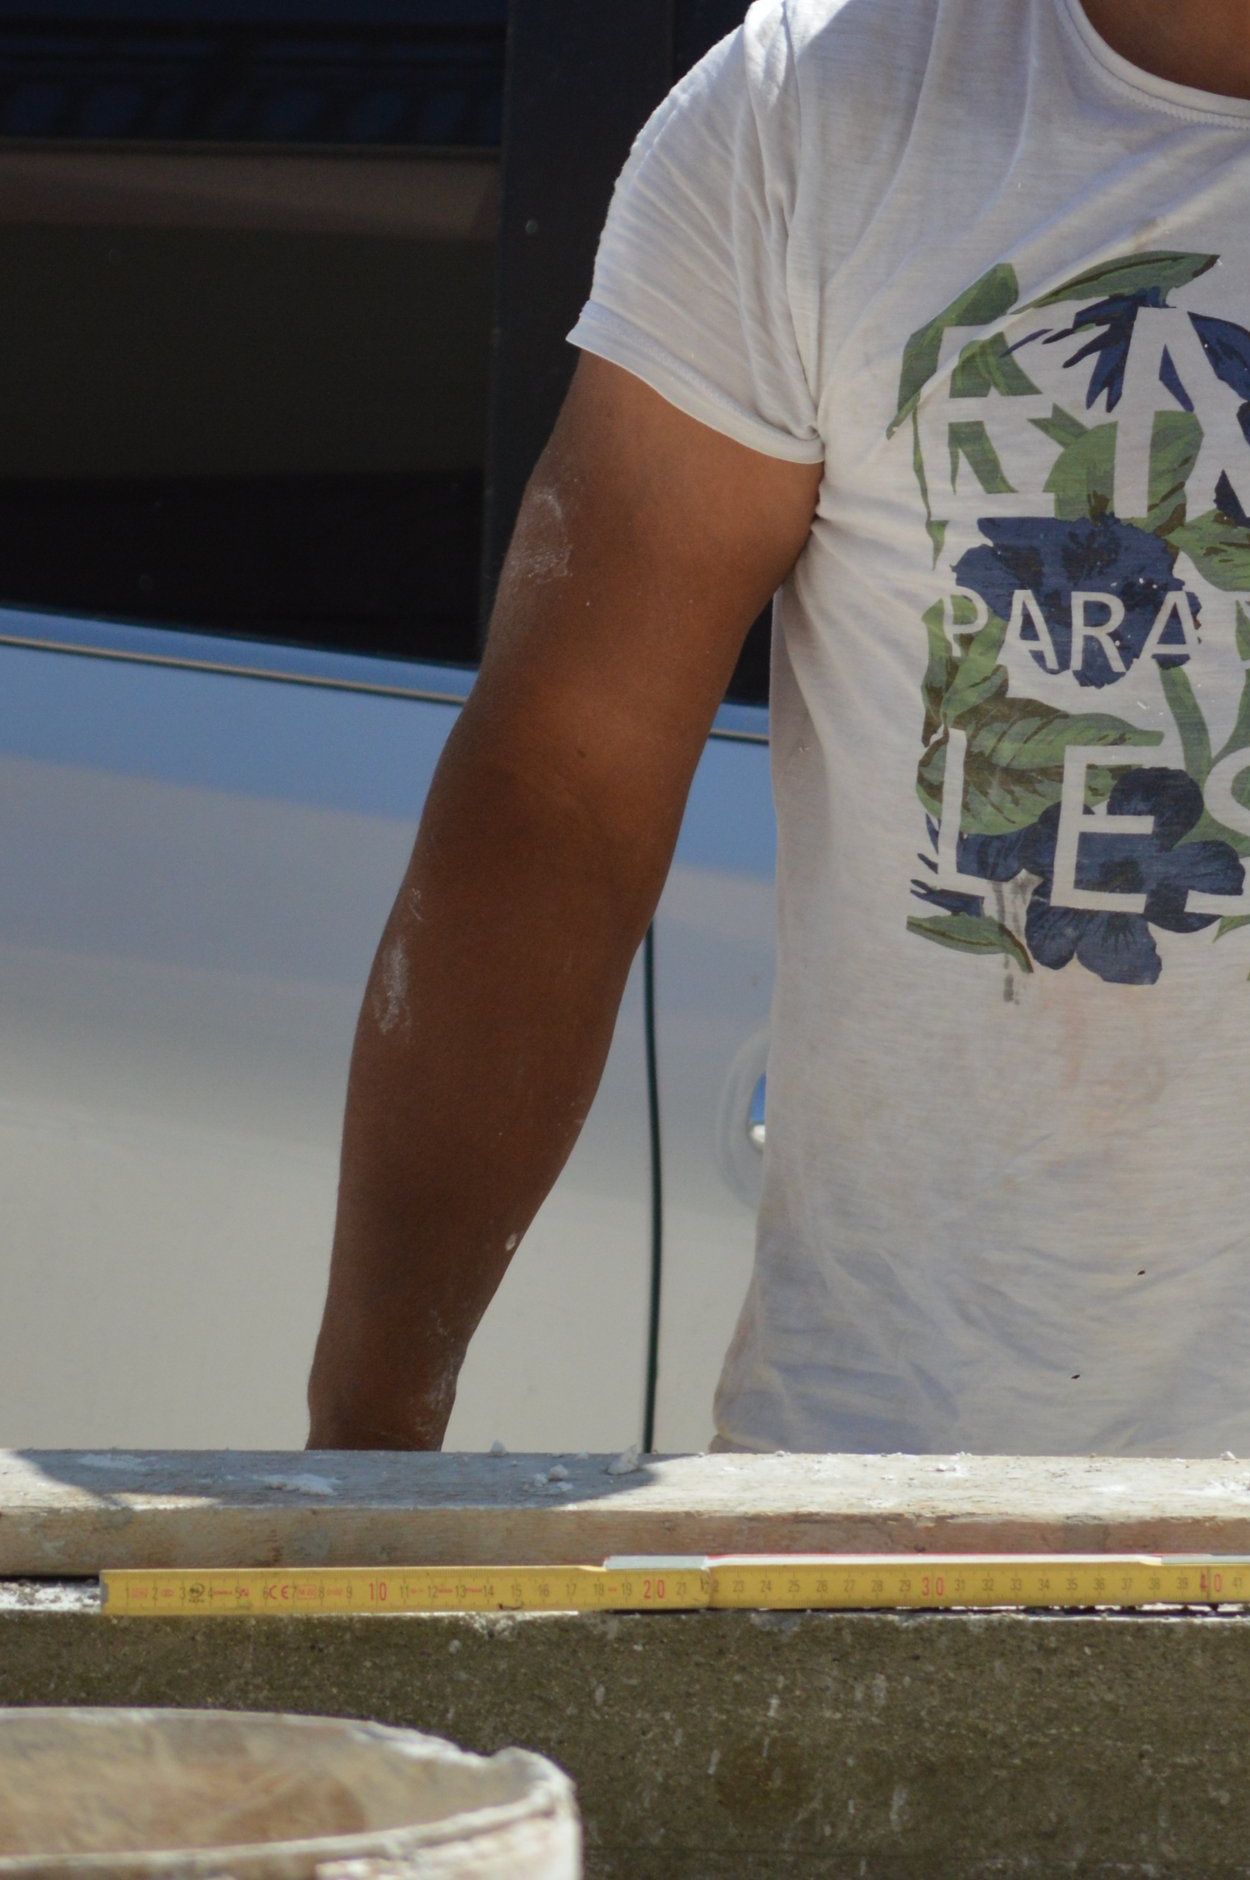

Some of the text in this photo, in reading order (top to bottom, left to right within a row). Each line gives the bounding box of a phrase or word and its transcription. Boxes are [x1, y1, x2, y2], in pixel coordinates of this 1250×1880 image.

[152, 1587, 159, 1600] 2
[369, 1582, 388, 1601] 10
[643, 1579, 666, 1600] 20
[922, 1576, 945, 1597] 30
